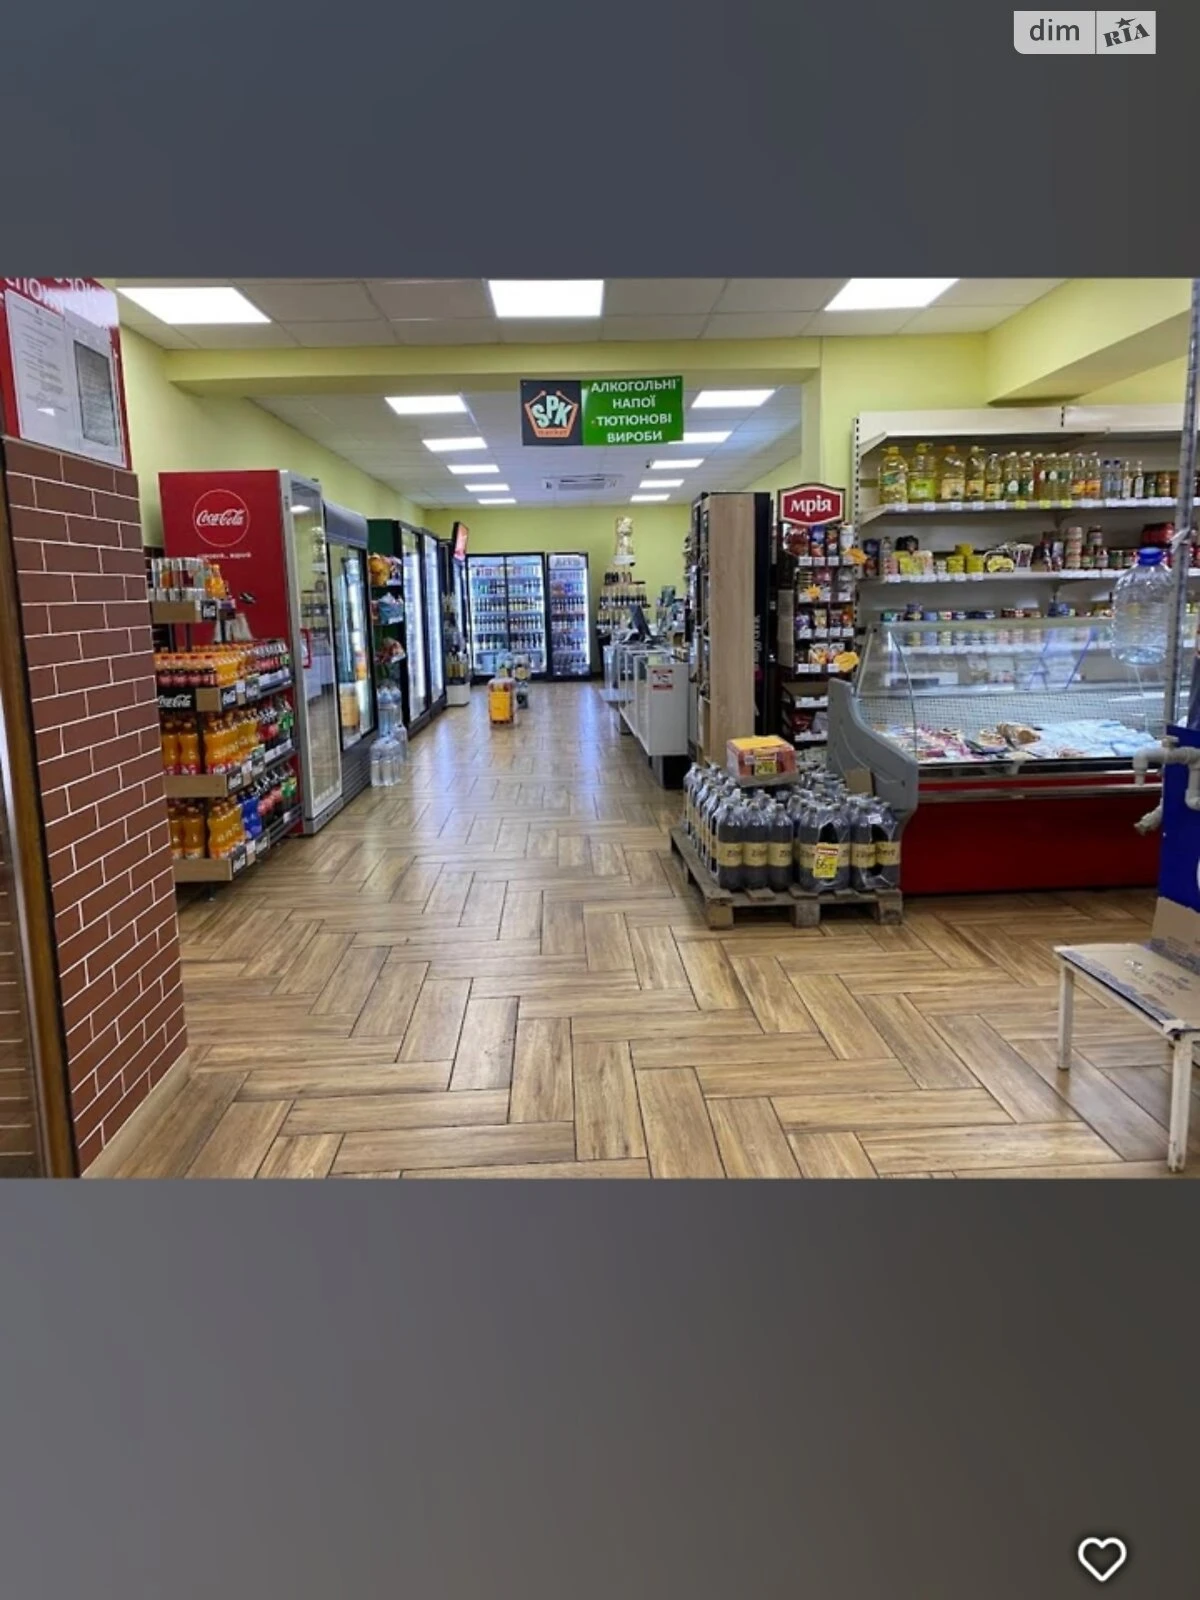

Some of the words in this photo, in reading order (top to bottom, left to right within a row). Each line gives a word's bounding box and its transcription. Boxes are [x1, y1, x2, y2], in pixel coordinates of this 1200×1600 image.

[591, 379, 676, 393] АЛКОГОЛЬНІ
[612, 394, 657, 409] НАПОЇ
[531, 395, 573, 428] SPK
[596, 413, 672, 427] ТЮТЮНОВІ
[607, 431, 663, 444] ВИРОБИ
[790, 494, 832, 517] мрія
[196, 508, 245, 527] Coca-Cola
